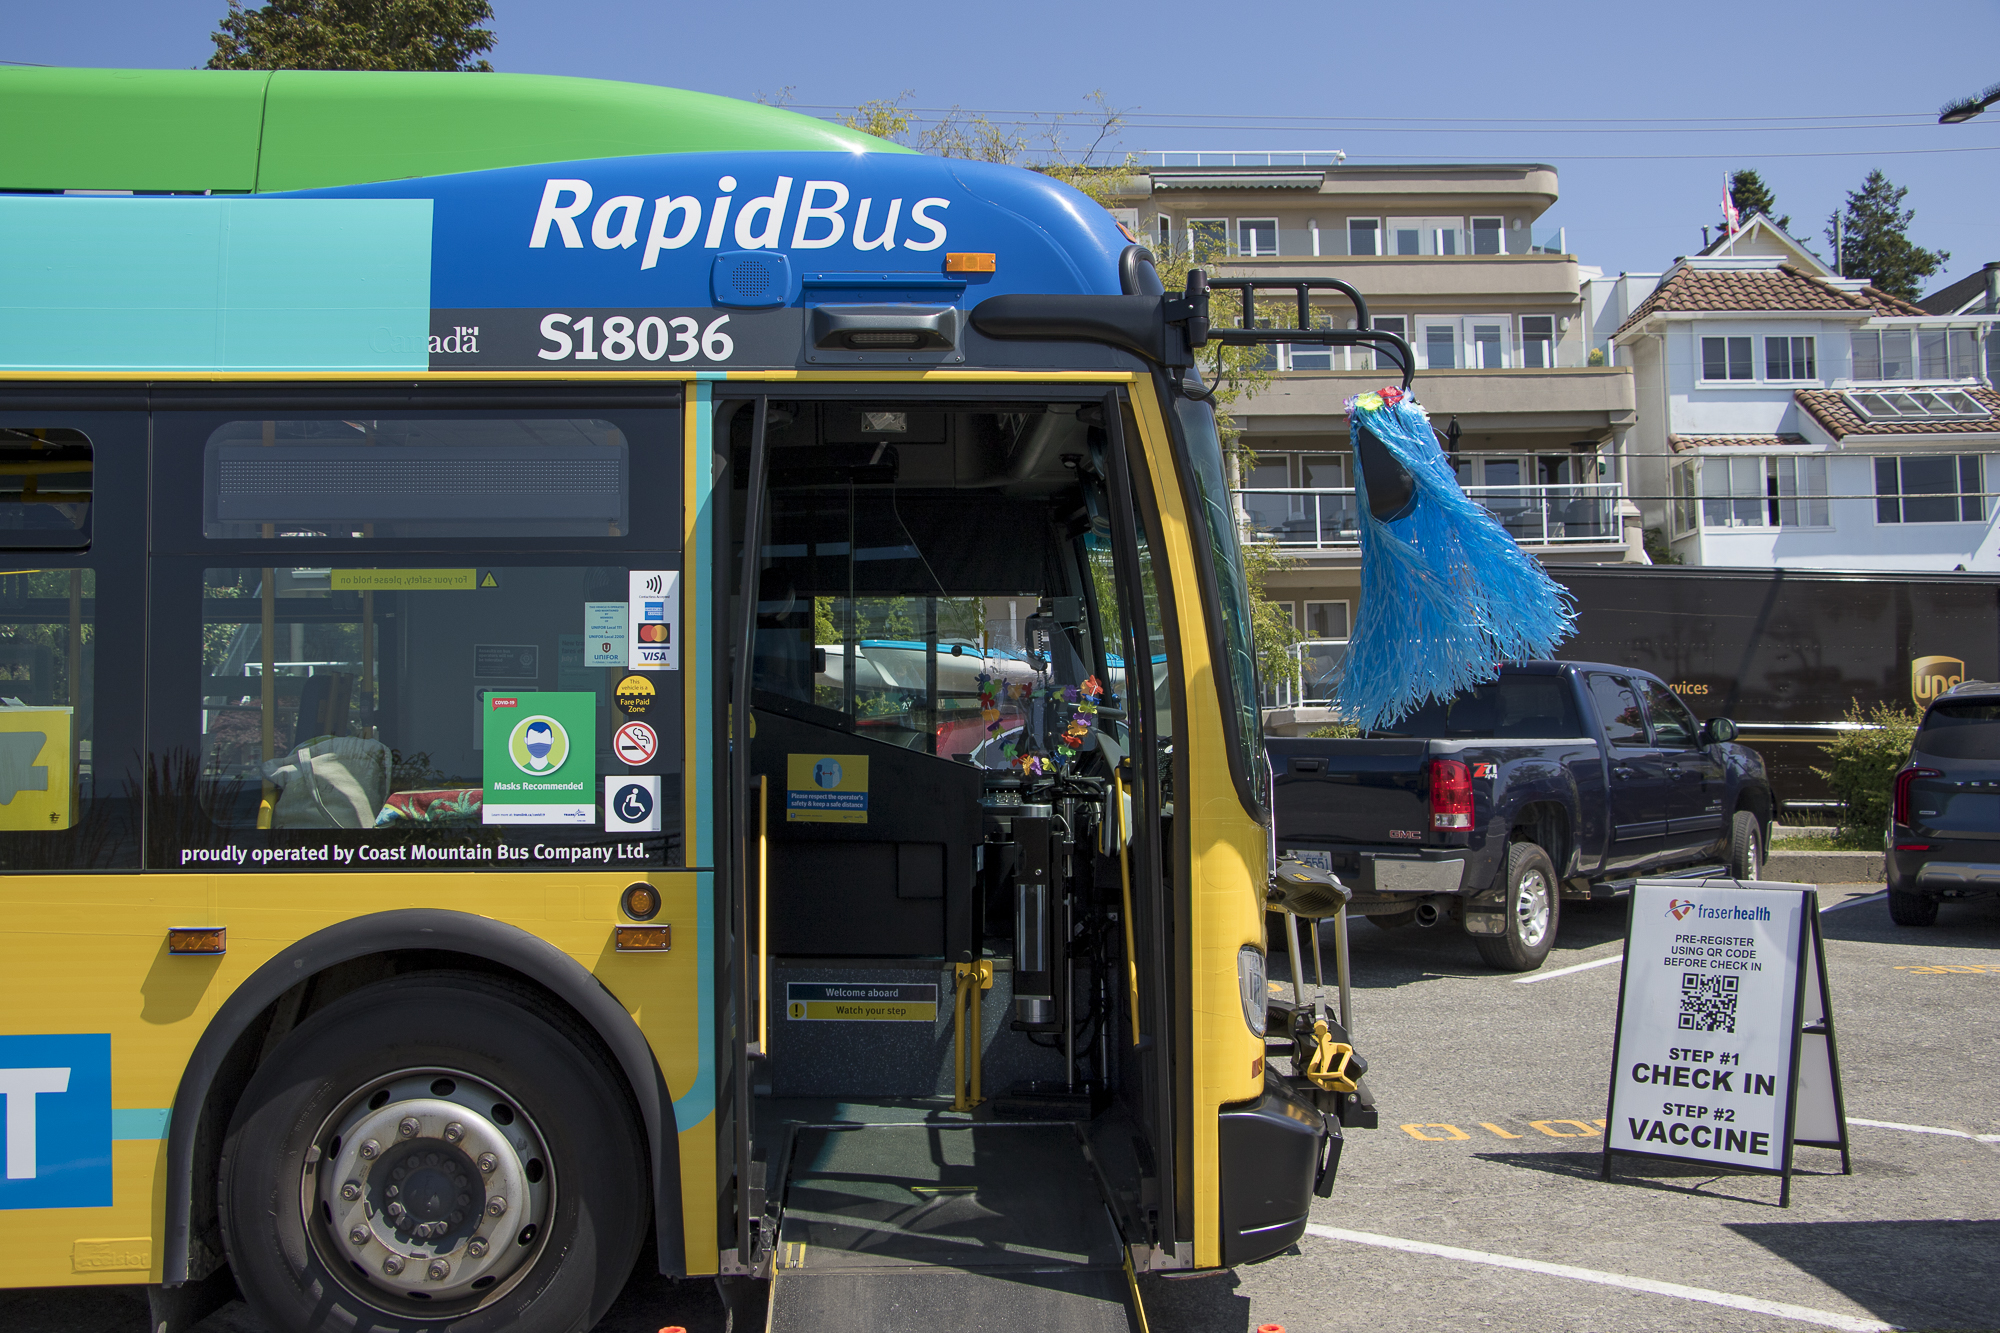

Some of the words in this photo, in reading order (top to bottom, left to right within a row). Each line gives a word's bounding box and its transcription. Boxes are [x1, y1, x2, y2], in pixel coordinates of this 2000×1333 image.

[528, 175, 951, 271] RapidBus
[537, 313, 734, 362] S18036
[641, 652, 666, 660] VISA
[494, 782, 520, 790] Masks
[522, 782, 583, 790] Recommended
[1390, 830, 1421, 840] GMC
[180, 845, 248, 865] proudly
[252, 845, 328, 865] operated
[333, 845, 354, 865] by
[358, 845, 406, 861] Coast
[410, 844, 492, 860] Mountain
[497, 844, 529, 860] Bus
[534, 844, 613, 863] Company
[617, 842, 650, 859] Ltd.
[1698, 904, 1770, 921] fraserhealth
[1674, 934, 1755, 947] PRE-REGISTER
[1671, 946, 1704, 956] USING
[1706, 948, 1723, 958] QR
[1725, 948, 1757, 959] CODE
[1663, 958, 1707, 968] BEFORE
[1710, 960, 1748, 971] CHECK
[1750, 962, 1762, 971] IN
[826, 988, 865, 997] Welcome
[868, 988, 898, 997] aboard
[836, 1006, 863, 1014] Watch
[865, 1008, 885, 1016] your
[887, 1007, 906, 1016] step
[1668, 1048, 1714, 1063] STEP
[1719, 1052, 1740, 1066] #1
[1631, 1063, 1734, 1092] CHECK
[1744, 1072, 1775, 1096] IN
[1662, 1102, 1708, 1119] STEP
[1713, 1107, 1735, 1123] #2
[1628, 1117, 1770, 1156] VACCINE
